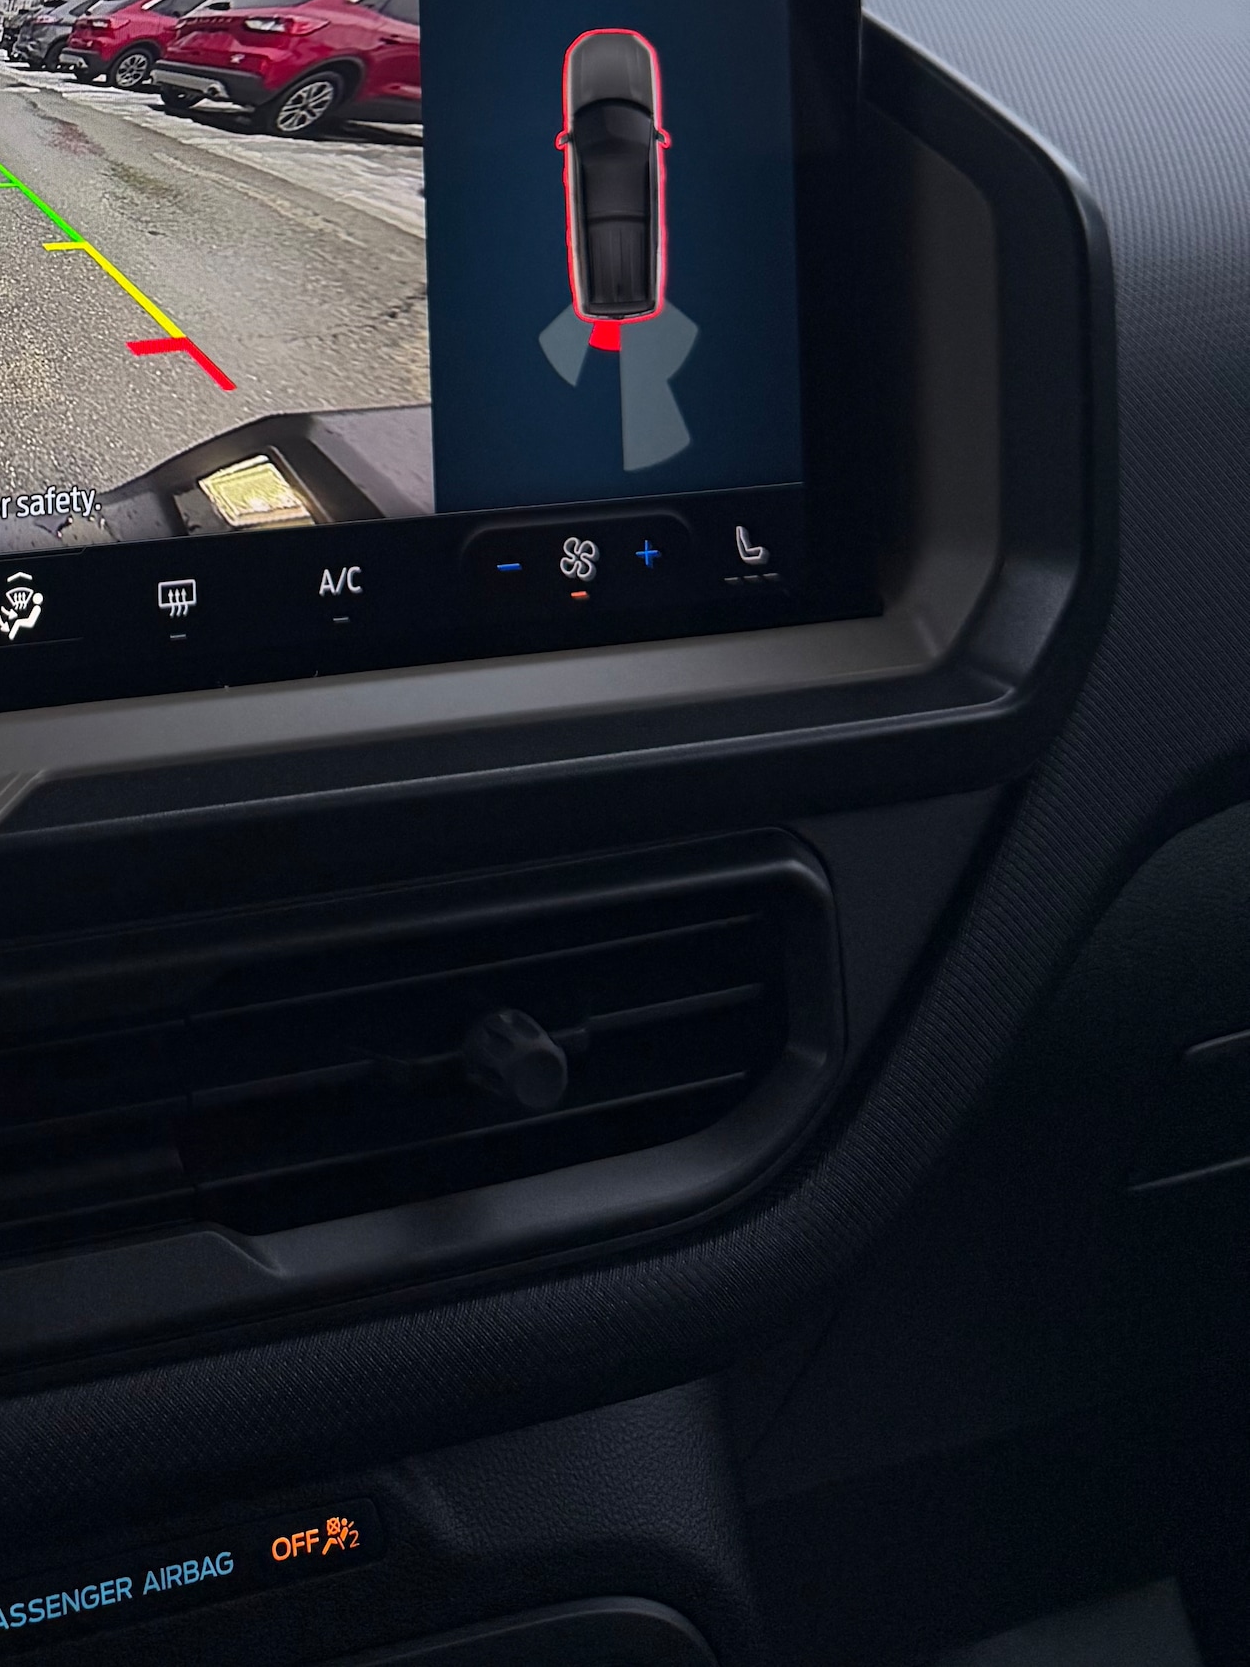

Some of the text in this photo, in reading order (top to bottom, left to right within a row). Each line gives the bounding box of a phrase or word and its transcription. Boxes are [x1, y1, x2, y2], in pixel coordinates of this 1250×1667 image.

[16, 485, 102, 518] safety.
[318, 565, 362, 596] A/C
[142, 1551, 234, 1596] AIRBAG
[271, 1528, 320, 1562] OFF
